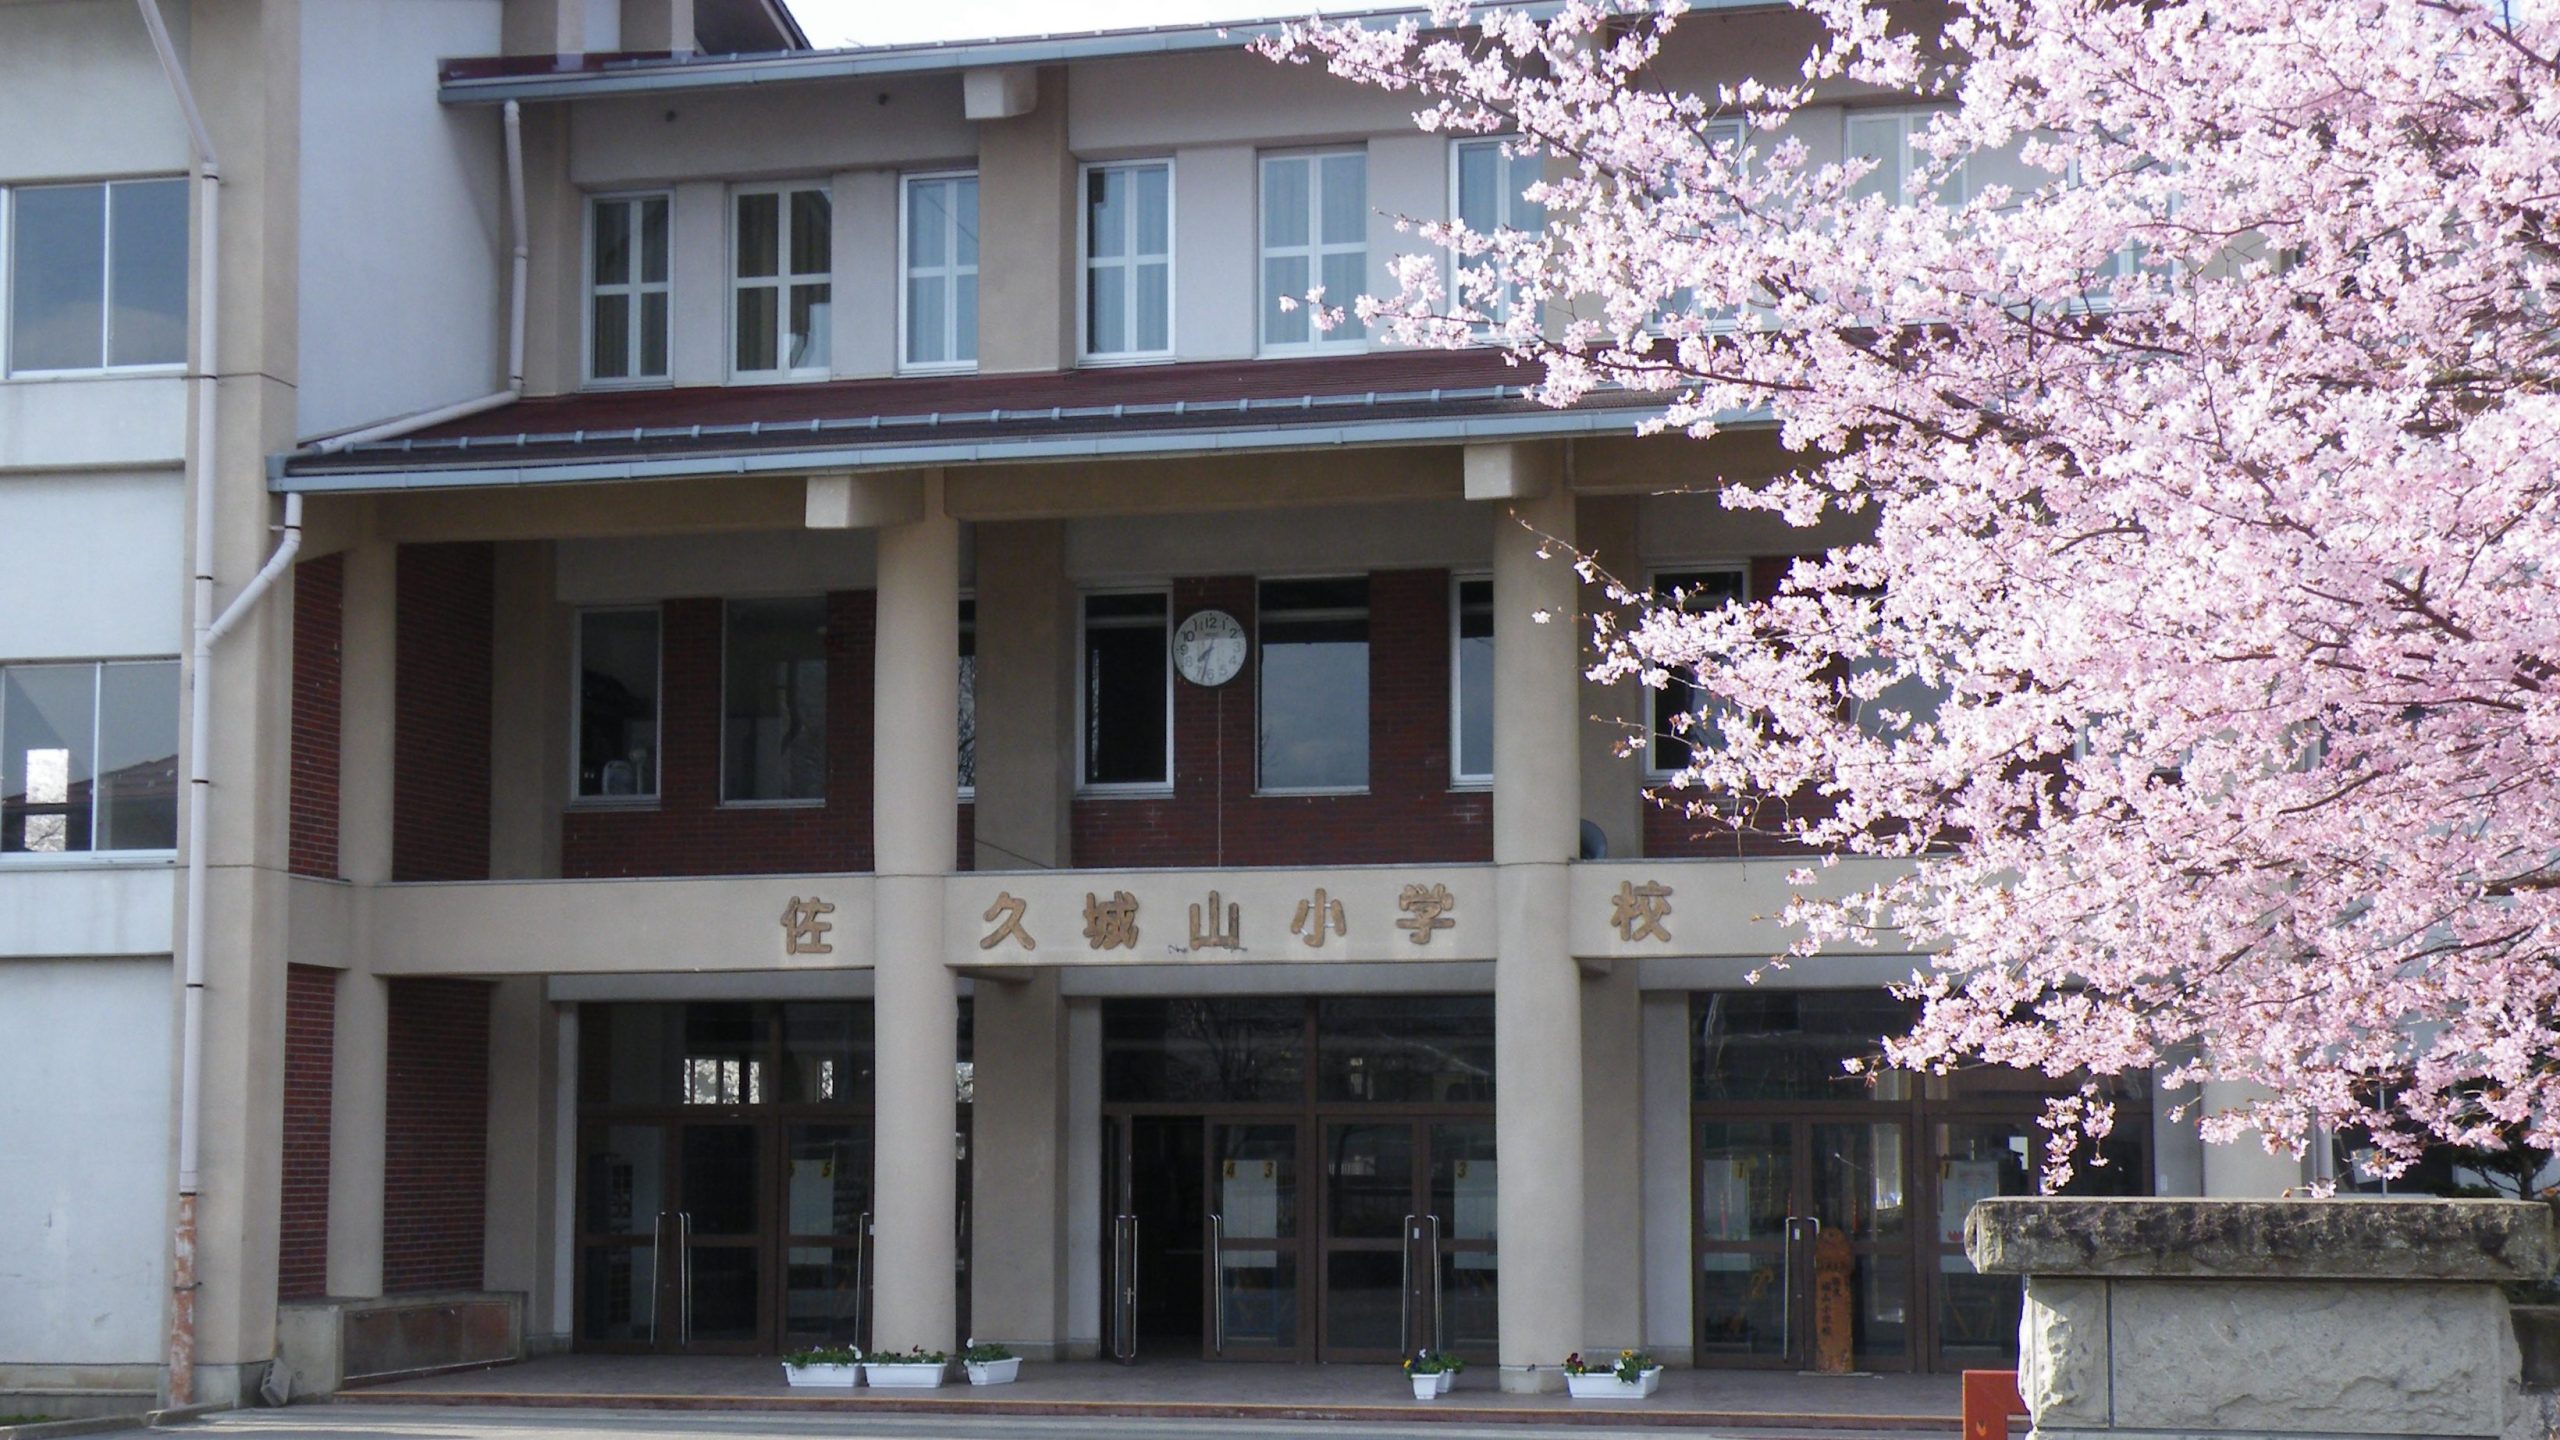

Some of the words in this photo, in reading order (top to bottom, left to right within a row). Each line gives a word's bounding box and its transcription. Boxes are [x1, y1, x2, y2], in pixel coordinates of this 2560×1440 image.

[1205, 617, 1217, 629] 12
[1181, 630, 1195, 642] 10
[1229, 628, 1237, 639] 2
[1180, 644, 1188, 656] 9
[1233, 641, 1241, 653] 3
[1184, 656, 1193, 667] 8
[1229, 655, 1237, 665] 4
[1207, 668, 1214, 680] 6
[1219, 665, 1228, 676] 5
[781, 879, 1672, 956] 佐久城山小学校
